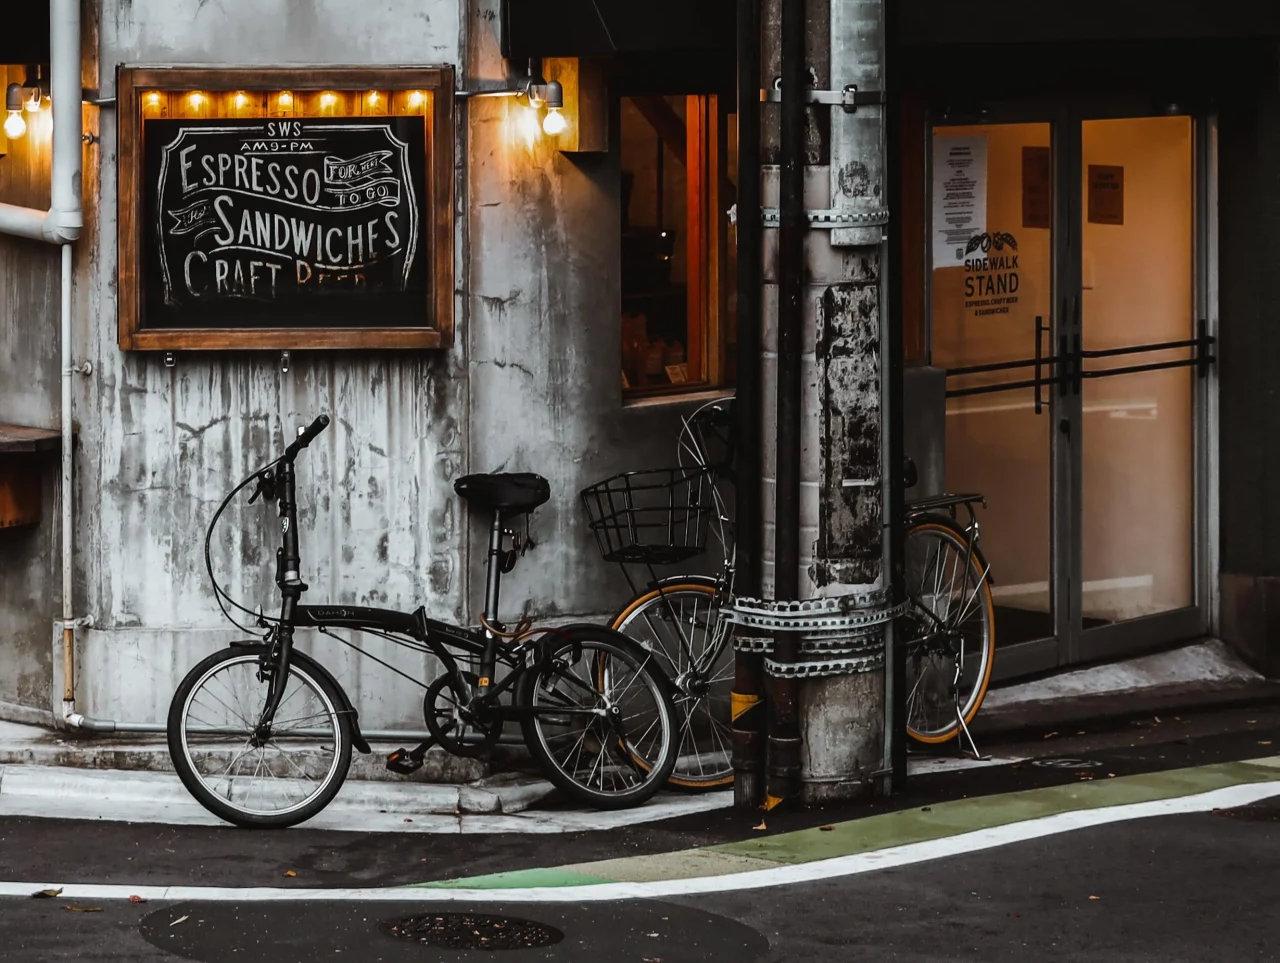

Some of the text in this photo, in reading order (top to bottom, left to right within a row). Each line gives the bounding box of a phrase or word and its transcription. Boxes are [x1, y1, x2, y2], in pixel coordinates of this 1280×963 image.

[268, 121, 302, 137] SWS
[179, 144, 321, 205] ESPRESSO
[336, 186, 389, 205] TO GO
[215, 195, 401, 263] SANDWICHES
[184, 250, 282, 300] CRAFT
[964, 255, 1019, 272] SIDEWALK
[965, 273, 1019, 297] STAND
